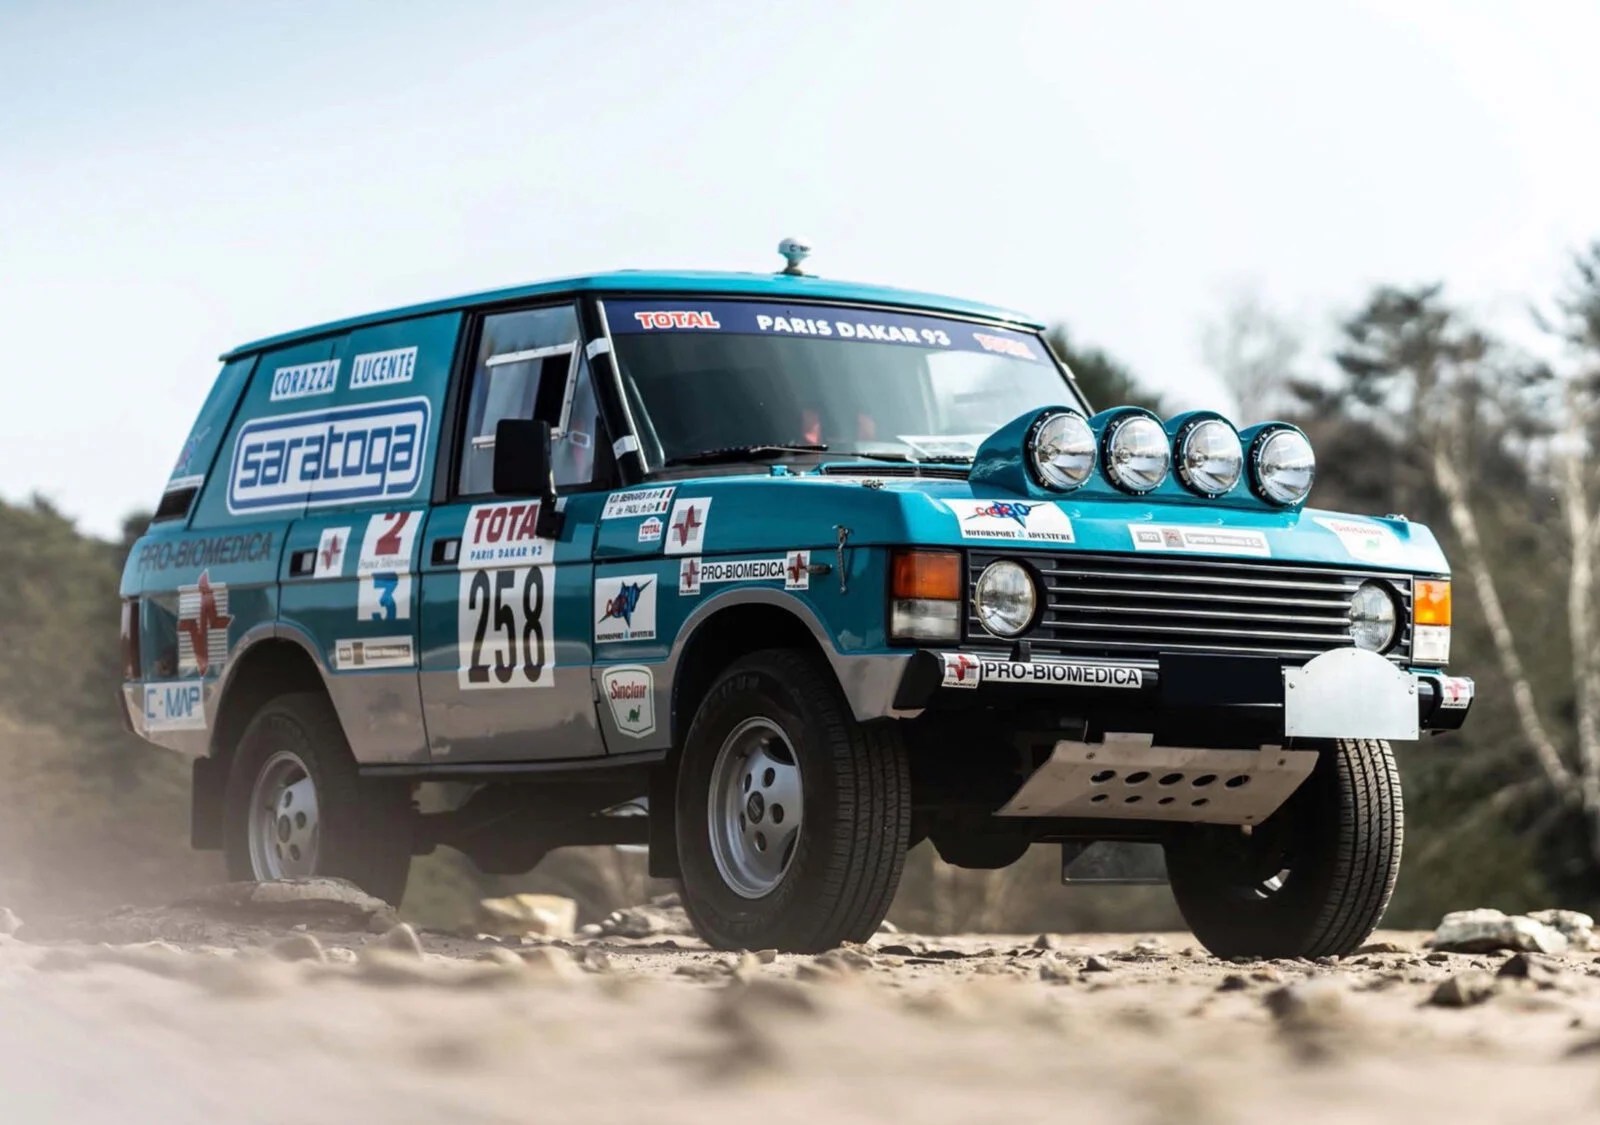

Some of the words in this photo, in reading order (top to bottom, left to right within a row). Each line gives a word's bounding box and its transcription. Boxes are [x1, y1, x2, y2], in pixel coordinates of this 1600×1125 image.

[635, 311, 721, 329] TOTAL
[756, 315, 832, 336] PARIS
[836, 321, 921, 343] DAKAR
[921, 328, 951, 346] 93
[275, 364, 335, 395] CORAZZA
[353, 352, 414, 384] LUCENTE
[239, 424, 417, 492] saratoga
[375, 512, 411, 556] 2
[473, 504, 539, 544] TOTA
[641, 524, 660, 534] TOTAL
[964, 529, 1015, 538] MOTORSPORT
[1027, 532, 1072, 540] ADVENTURE
[138, 532, 272, 571] PRO-BIOMEDICA
[471, 549, 494, 560] PARIS
[498, 547, 527, 558] DAKAR
[532, 546, 542, 556] 93
[701, 562, 784, 580] PRO-BIOMEDICA
[371, 572, 398, 619] 3
[468, 566, 545, 683] 258
[611, 679, 647, 699] Sinclair
[985, 662, 1140, 685] PRO-BIOMEDICA
